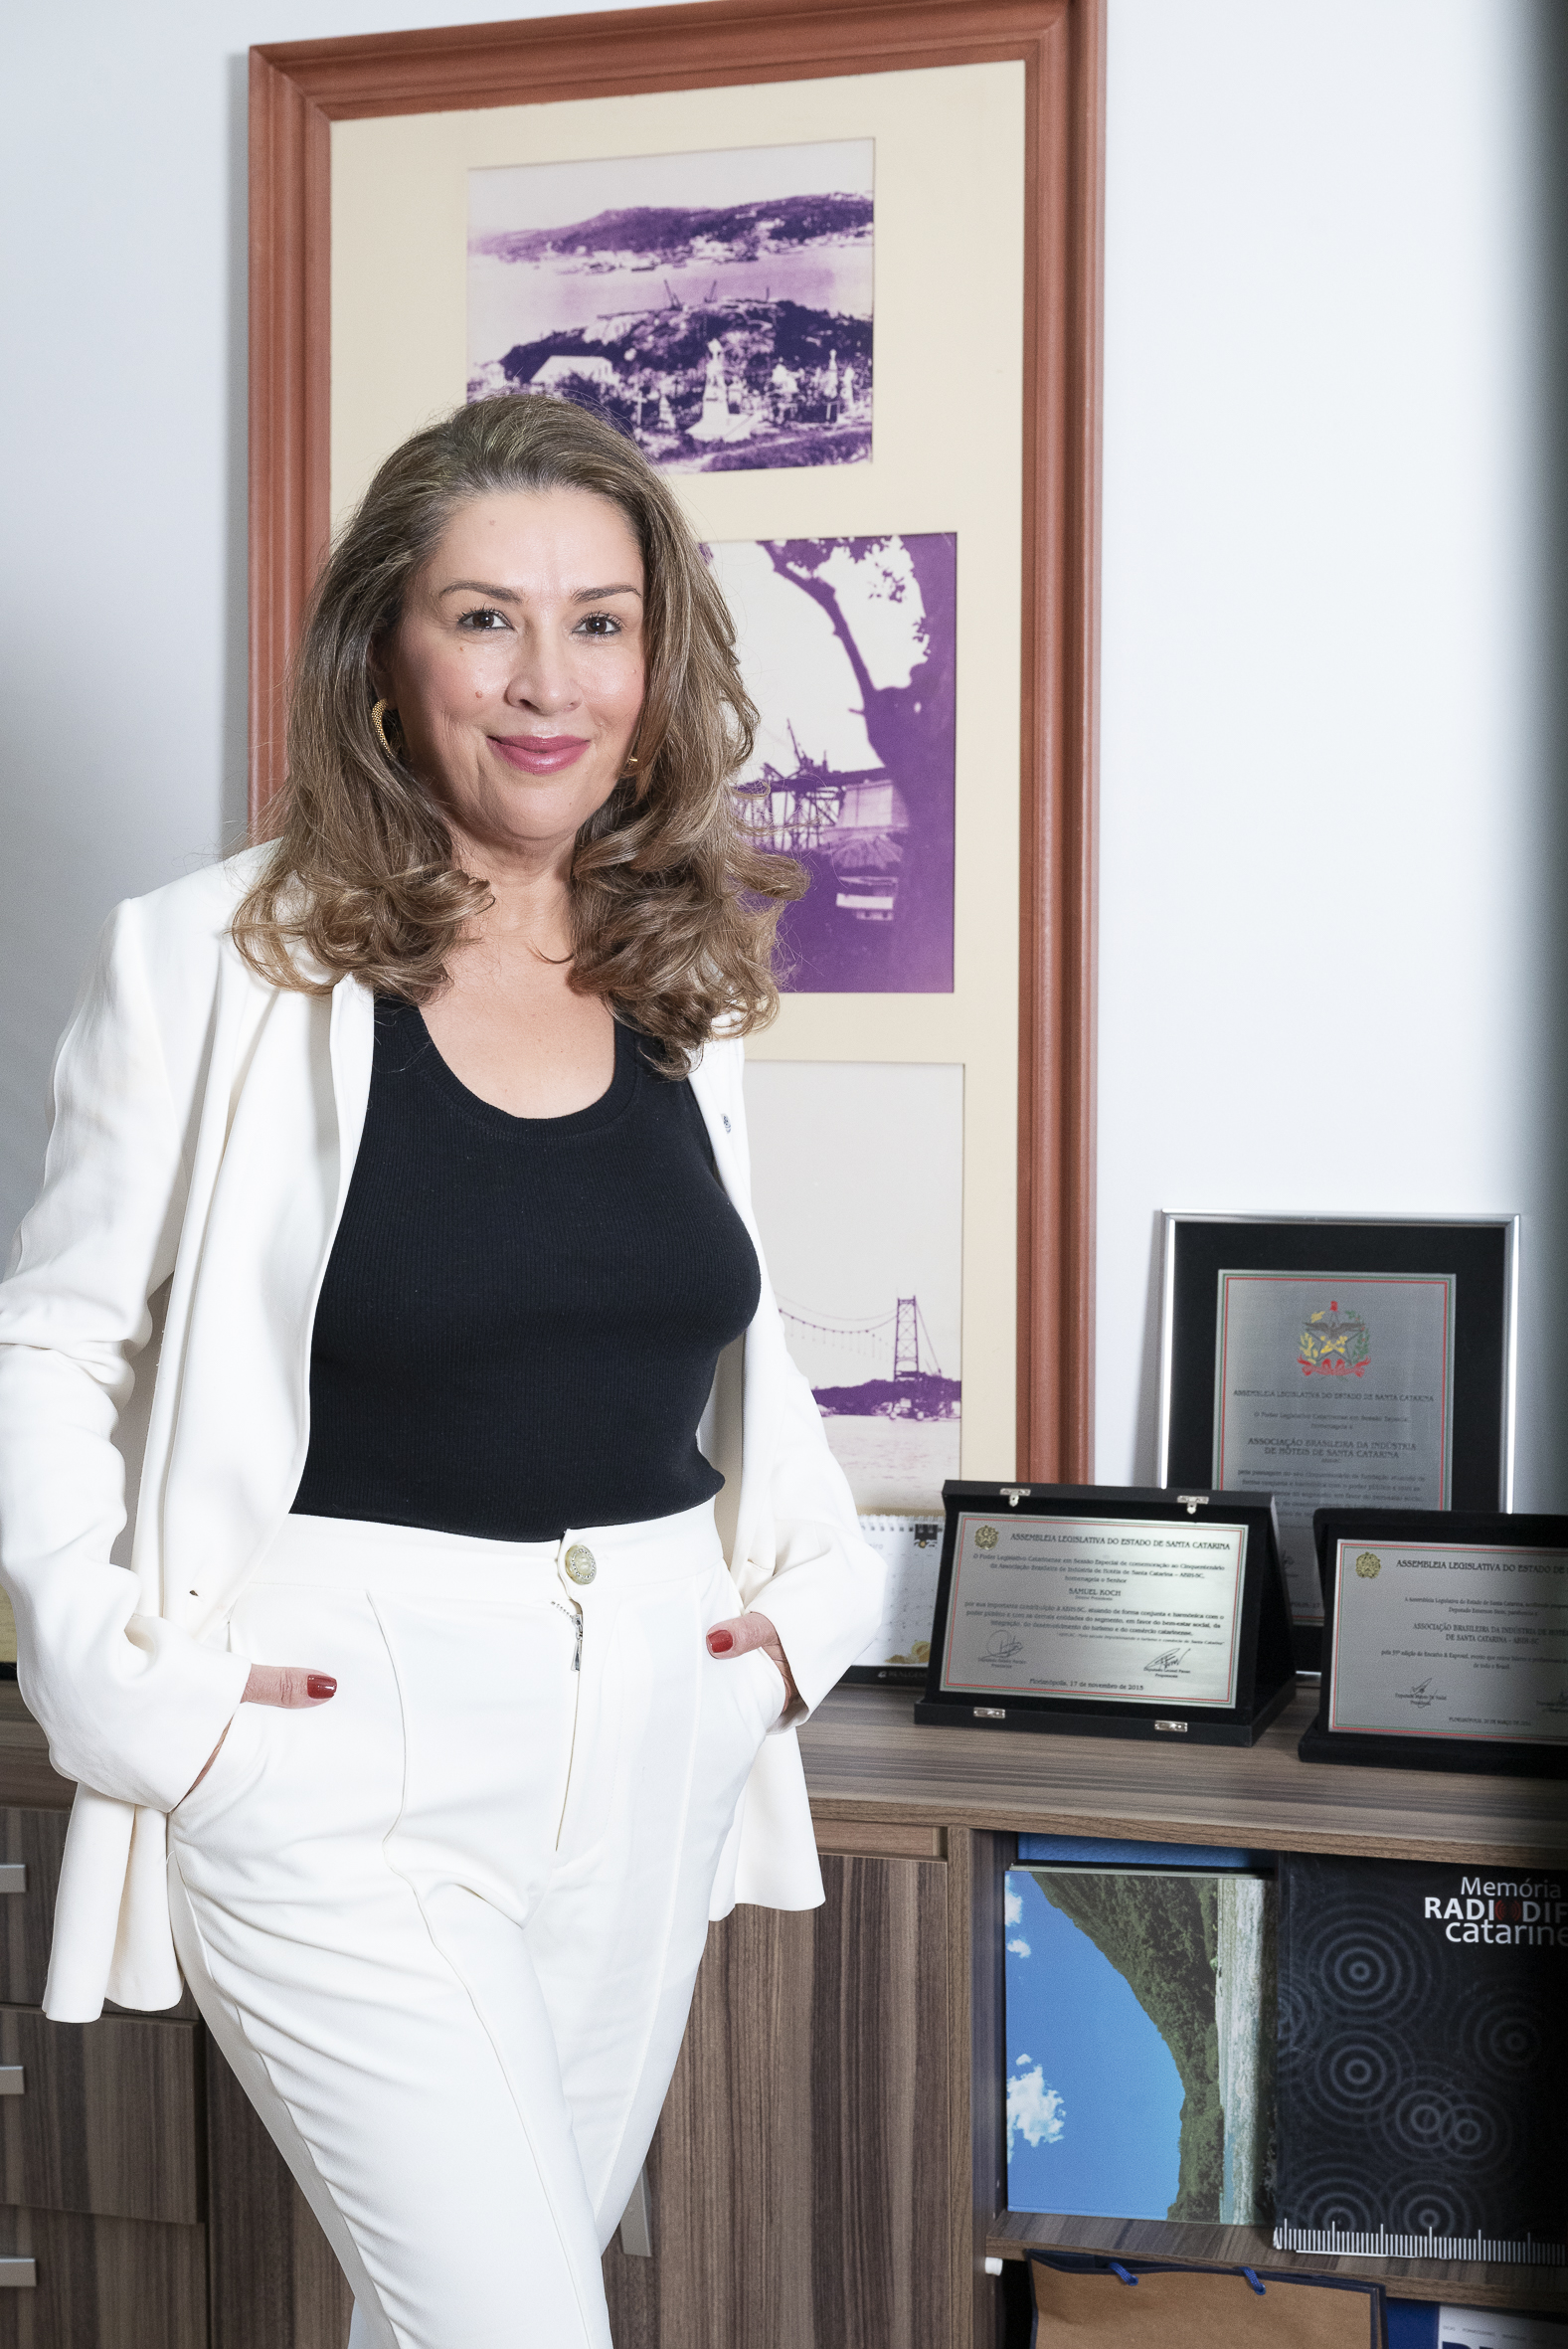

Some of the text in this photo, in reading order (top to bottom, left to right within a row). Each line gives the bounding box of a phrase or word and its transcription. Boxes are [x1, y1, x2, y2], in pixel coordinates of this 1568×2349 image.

[1355, 1450, 1400, 1459] CATARINA
[1010, 1533, 1056, 1542] ASSEMBLEIA
[1058, 1536, 1106, 1544] LEGISLATIVA
[1121, 1537, 1151, 1546] ESTADO
[1165, 1539, 1190, 1548] SANTA
[1192, 1541, 1231, 1550] CATARINA
[1396, 1559, 1447, 1569] ASSEMBLEIA
[1449, 1561, 1500, 1571] LEGISLATIVA
[1502, 1563, 1516, 1572] DO
[1517, 1564, 1551, 1573] ESTADO
[1552, 1565, 1565, 1574] DE
[1413, 1622, 1452, 1632] ASSOCIAÇÃO
[1453, 1624, 1489, 1633] BRASILEIRA
[1477, 1635, 1507, 1644] CATARINA
[1460, 1877, 1563, 1899] Memória
